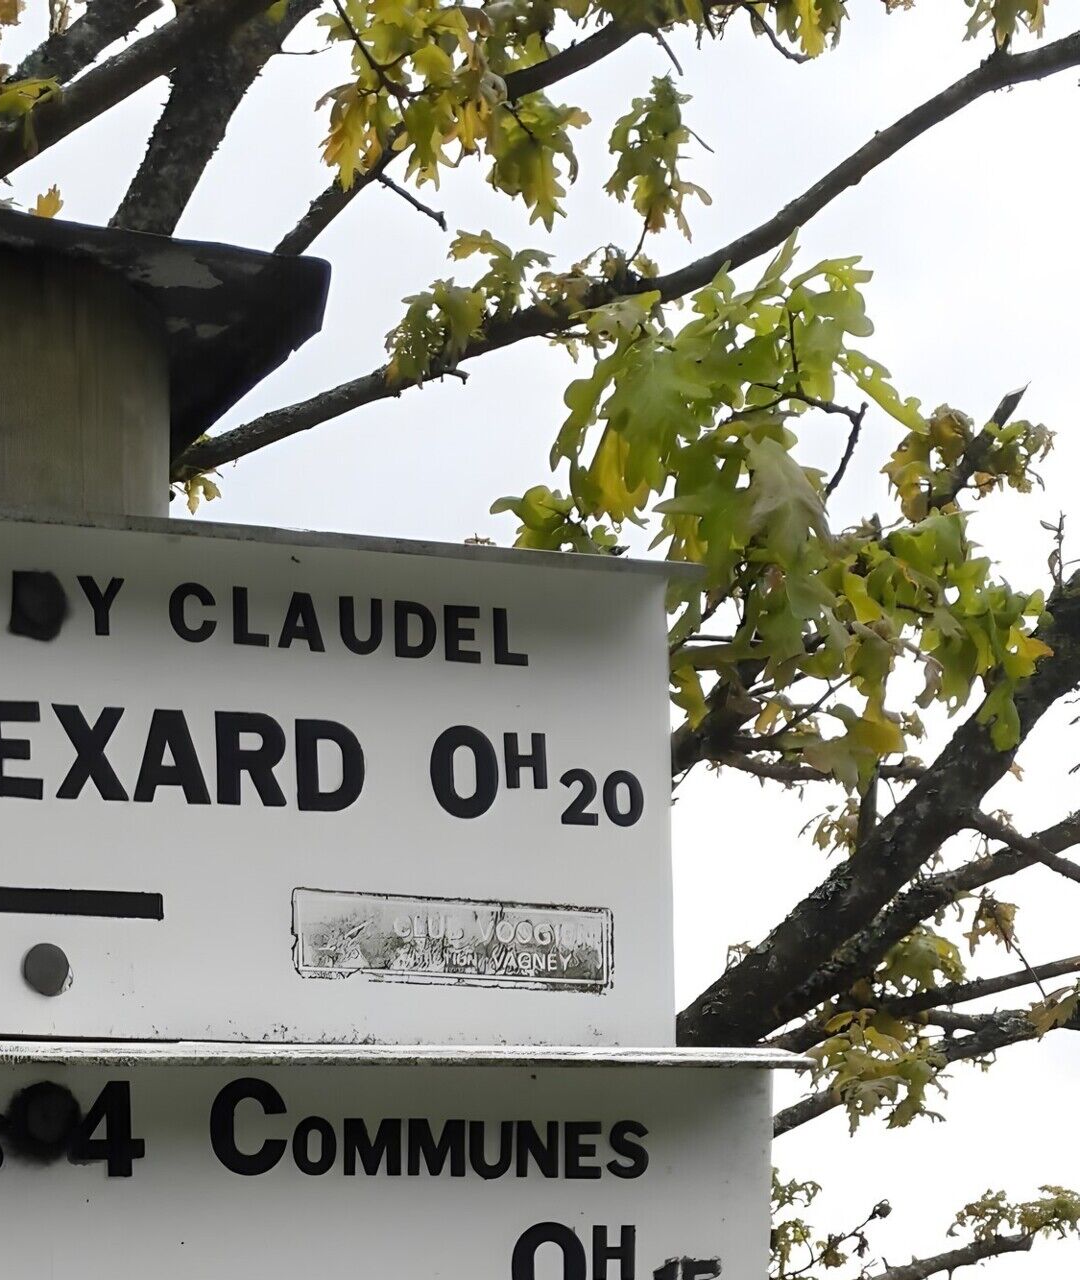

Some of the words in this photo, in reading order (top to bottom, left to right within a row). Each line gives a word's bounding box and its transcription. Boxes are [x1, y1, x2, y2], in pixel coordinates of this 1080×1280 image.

[169, 583, 528, 666] CLAUDEL
[493, 950, 572, 972] VAGNEY
[65, 1081, 145, 1177] 4
